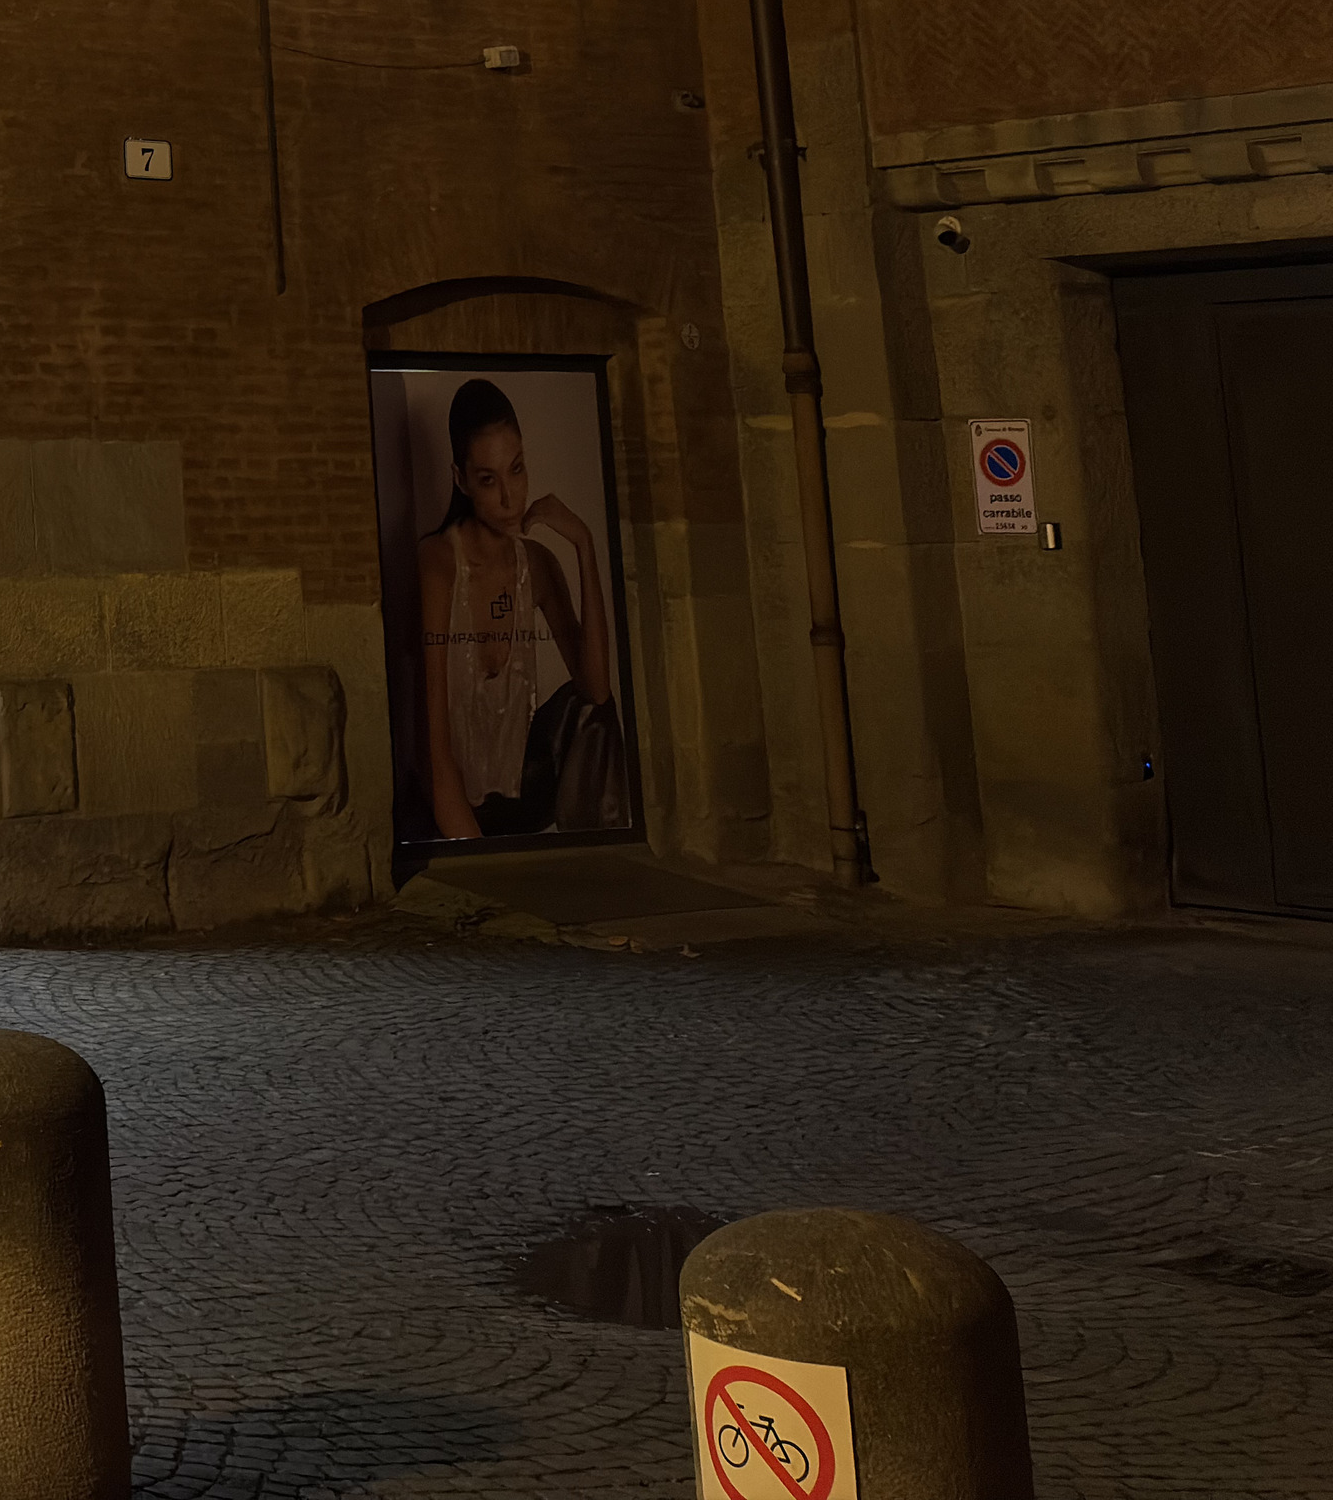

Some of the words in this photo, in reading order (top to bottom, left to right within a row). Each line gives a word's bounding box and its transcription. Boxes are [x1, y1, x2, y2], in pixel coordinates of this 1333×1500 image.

[141, 147, 155, 172] 7
[989, 493, 1022, 504] passo
[982, 507, 1033, 518] carrabile
[424, 631, 510, 646] COMPAGNIA
